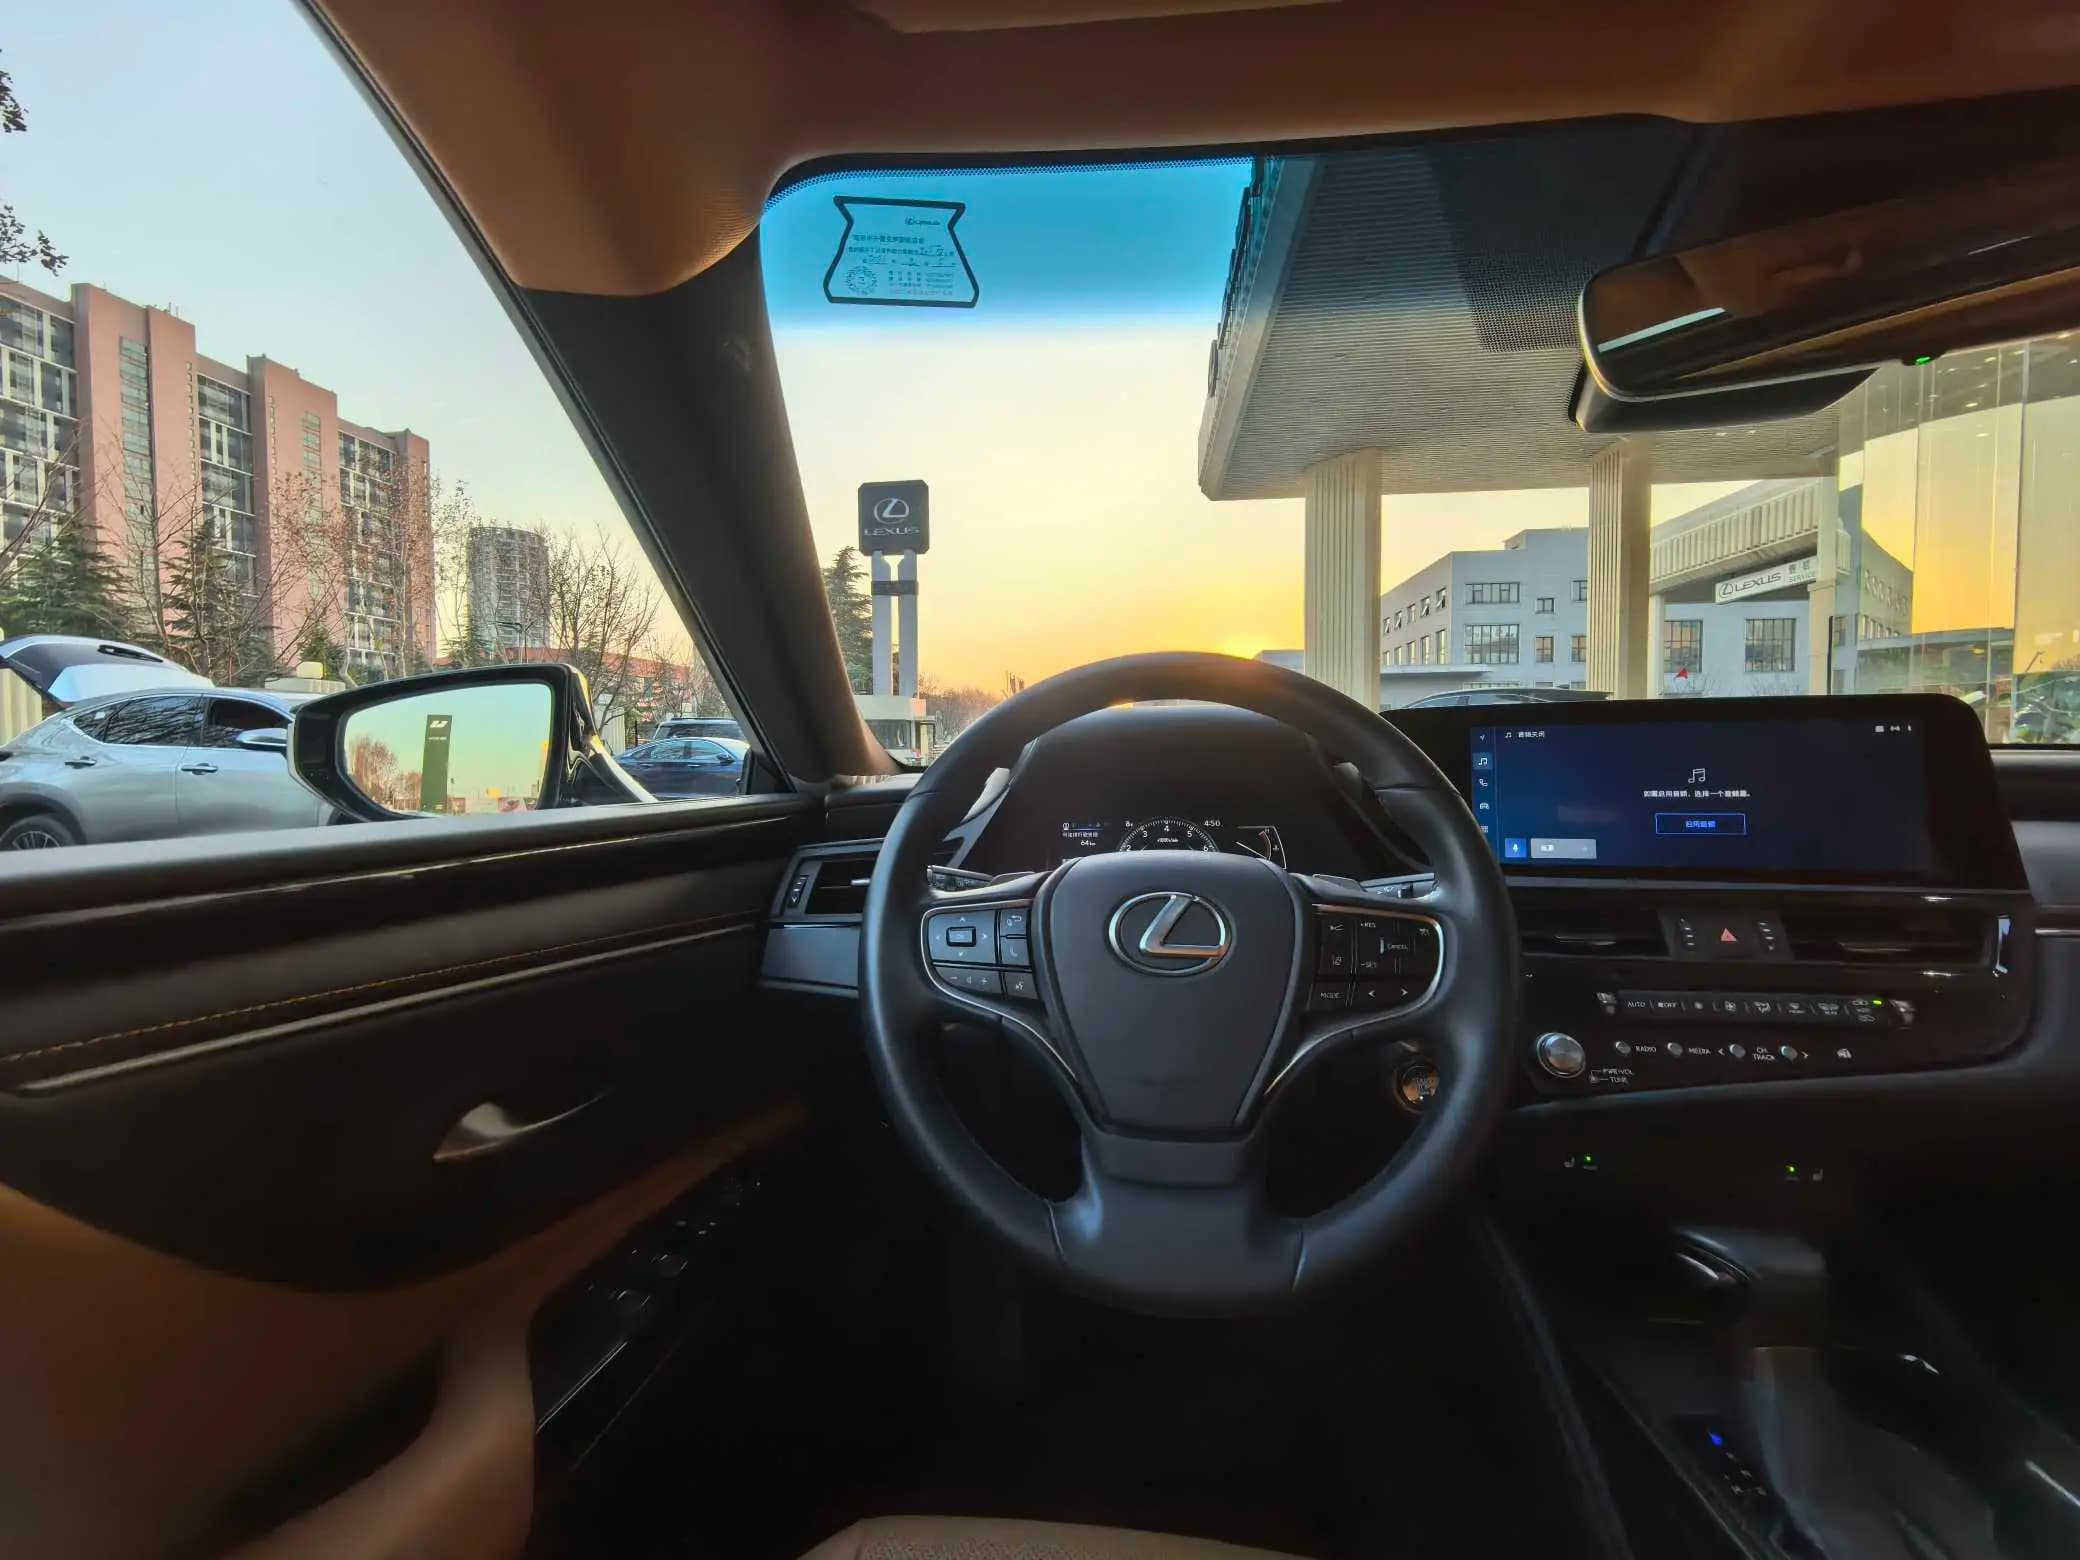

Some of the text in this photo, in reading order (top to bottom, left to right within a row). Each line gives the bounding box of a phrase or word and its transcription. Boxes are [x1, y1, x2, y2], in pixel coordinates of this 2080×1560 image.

[864, 527, 920, 536] LEXUS
[1735, 572, 1781, 591] LEXUS
[1634, 1045, 1656, 1053] RADIO
[1688, 1047, 1711, 1055] MEDIA
